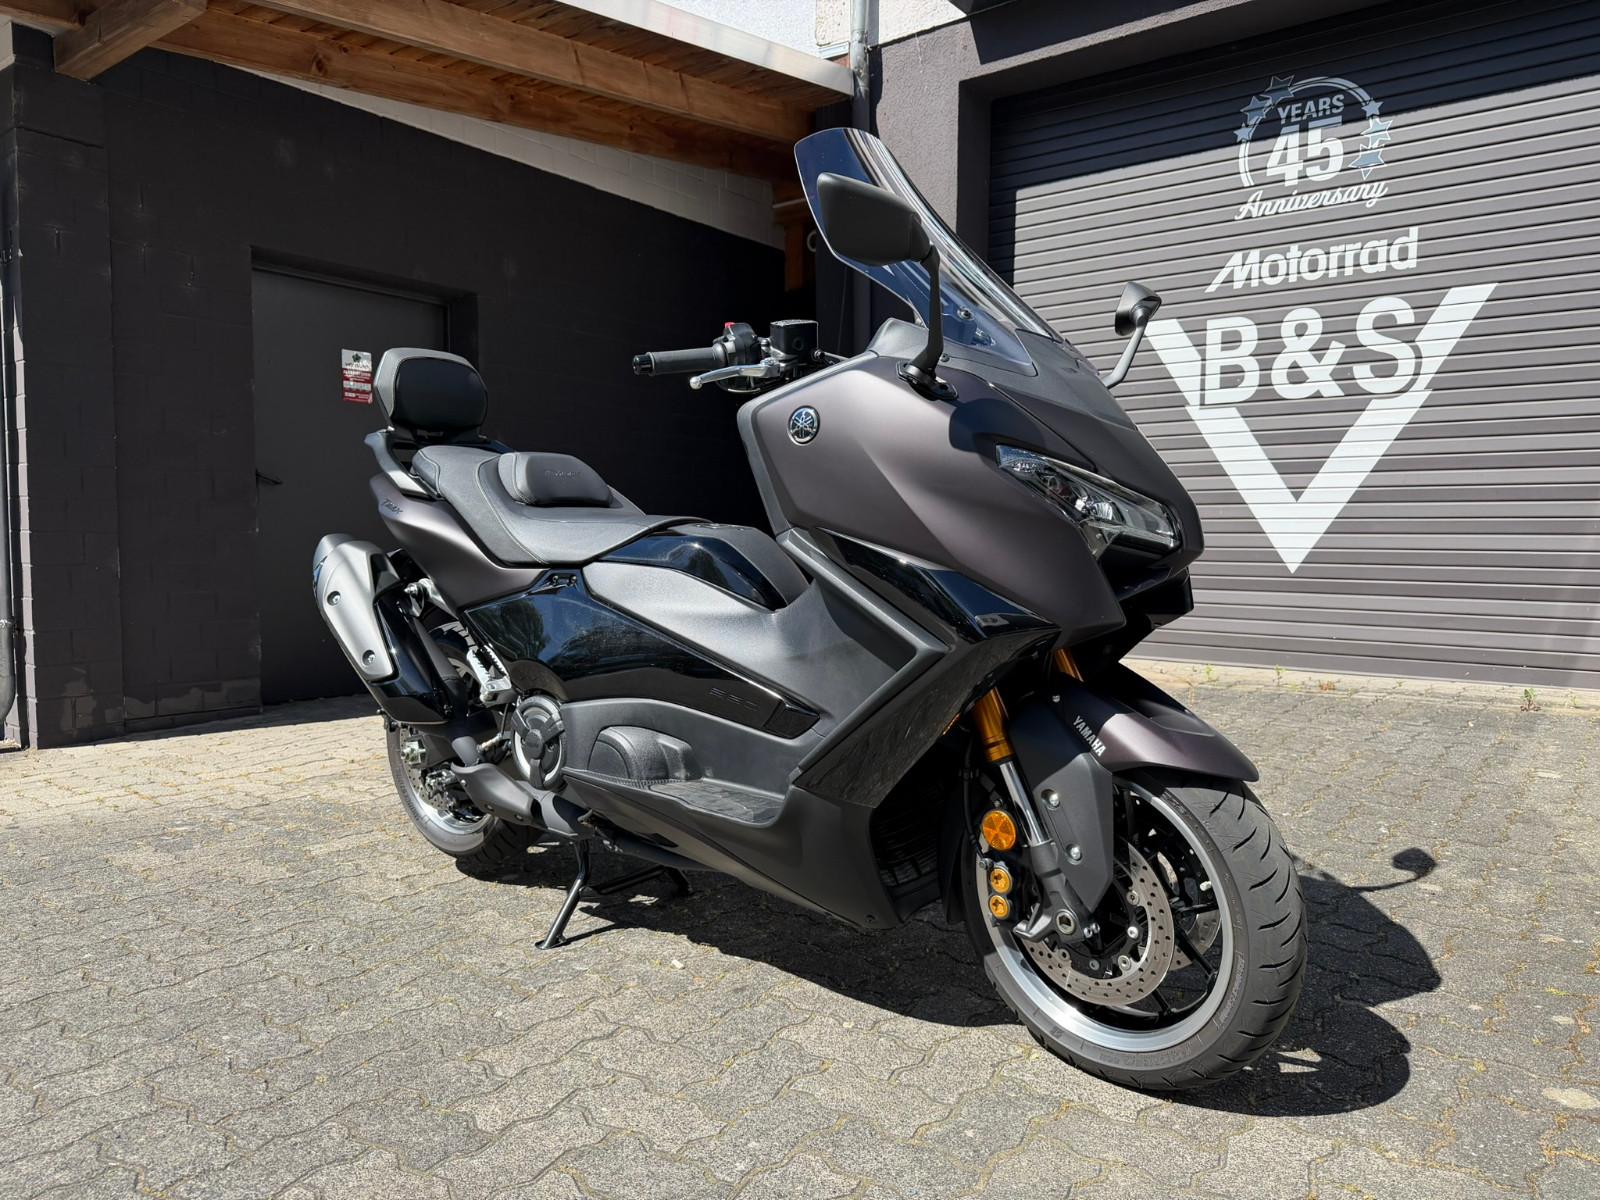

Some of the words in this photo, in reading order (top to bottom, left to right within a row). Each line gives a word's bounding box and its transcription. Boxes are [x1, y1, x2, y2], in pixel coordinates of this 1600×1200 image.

[1277, 94, 1345, 124] YEARS
[1266, 115, 1345, 187] 45
[1234, 181, 1389, 221] Anniversary
[1204, 226, 1419, 293] Motorrad
[1204, 297, 1417, 405] B&S
[1073, 715, 1106, 757] YAMAHA
